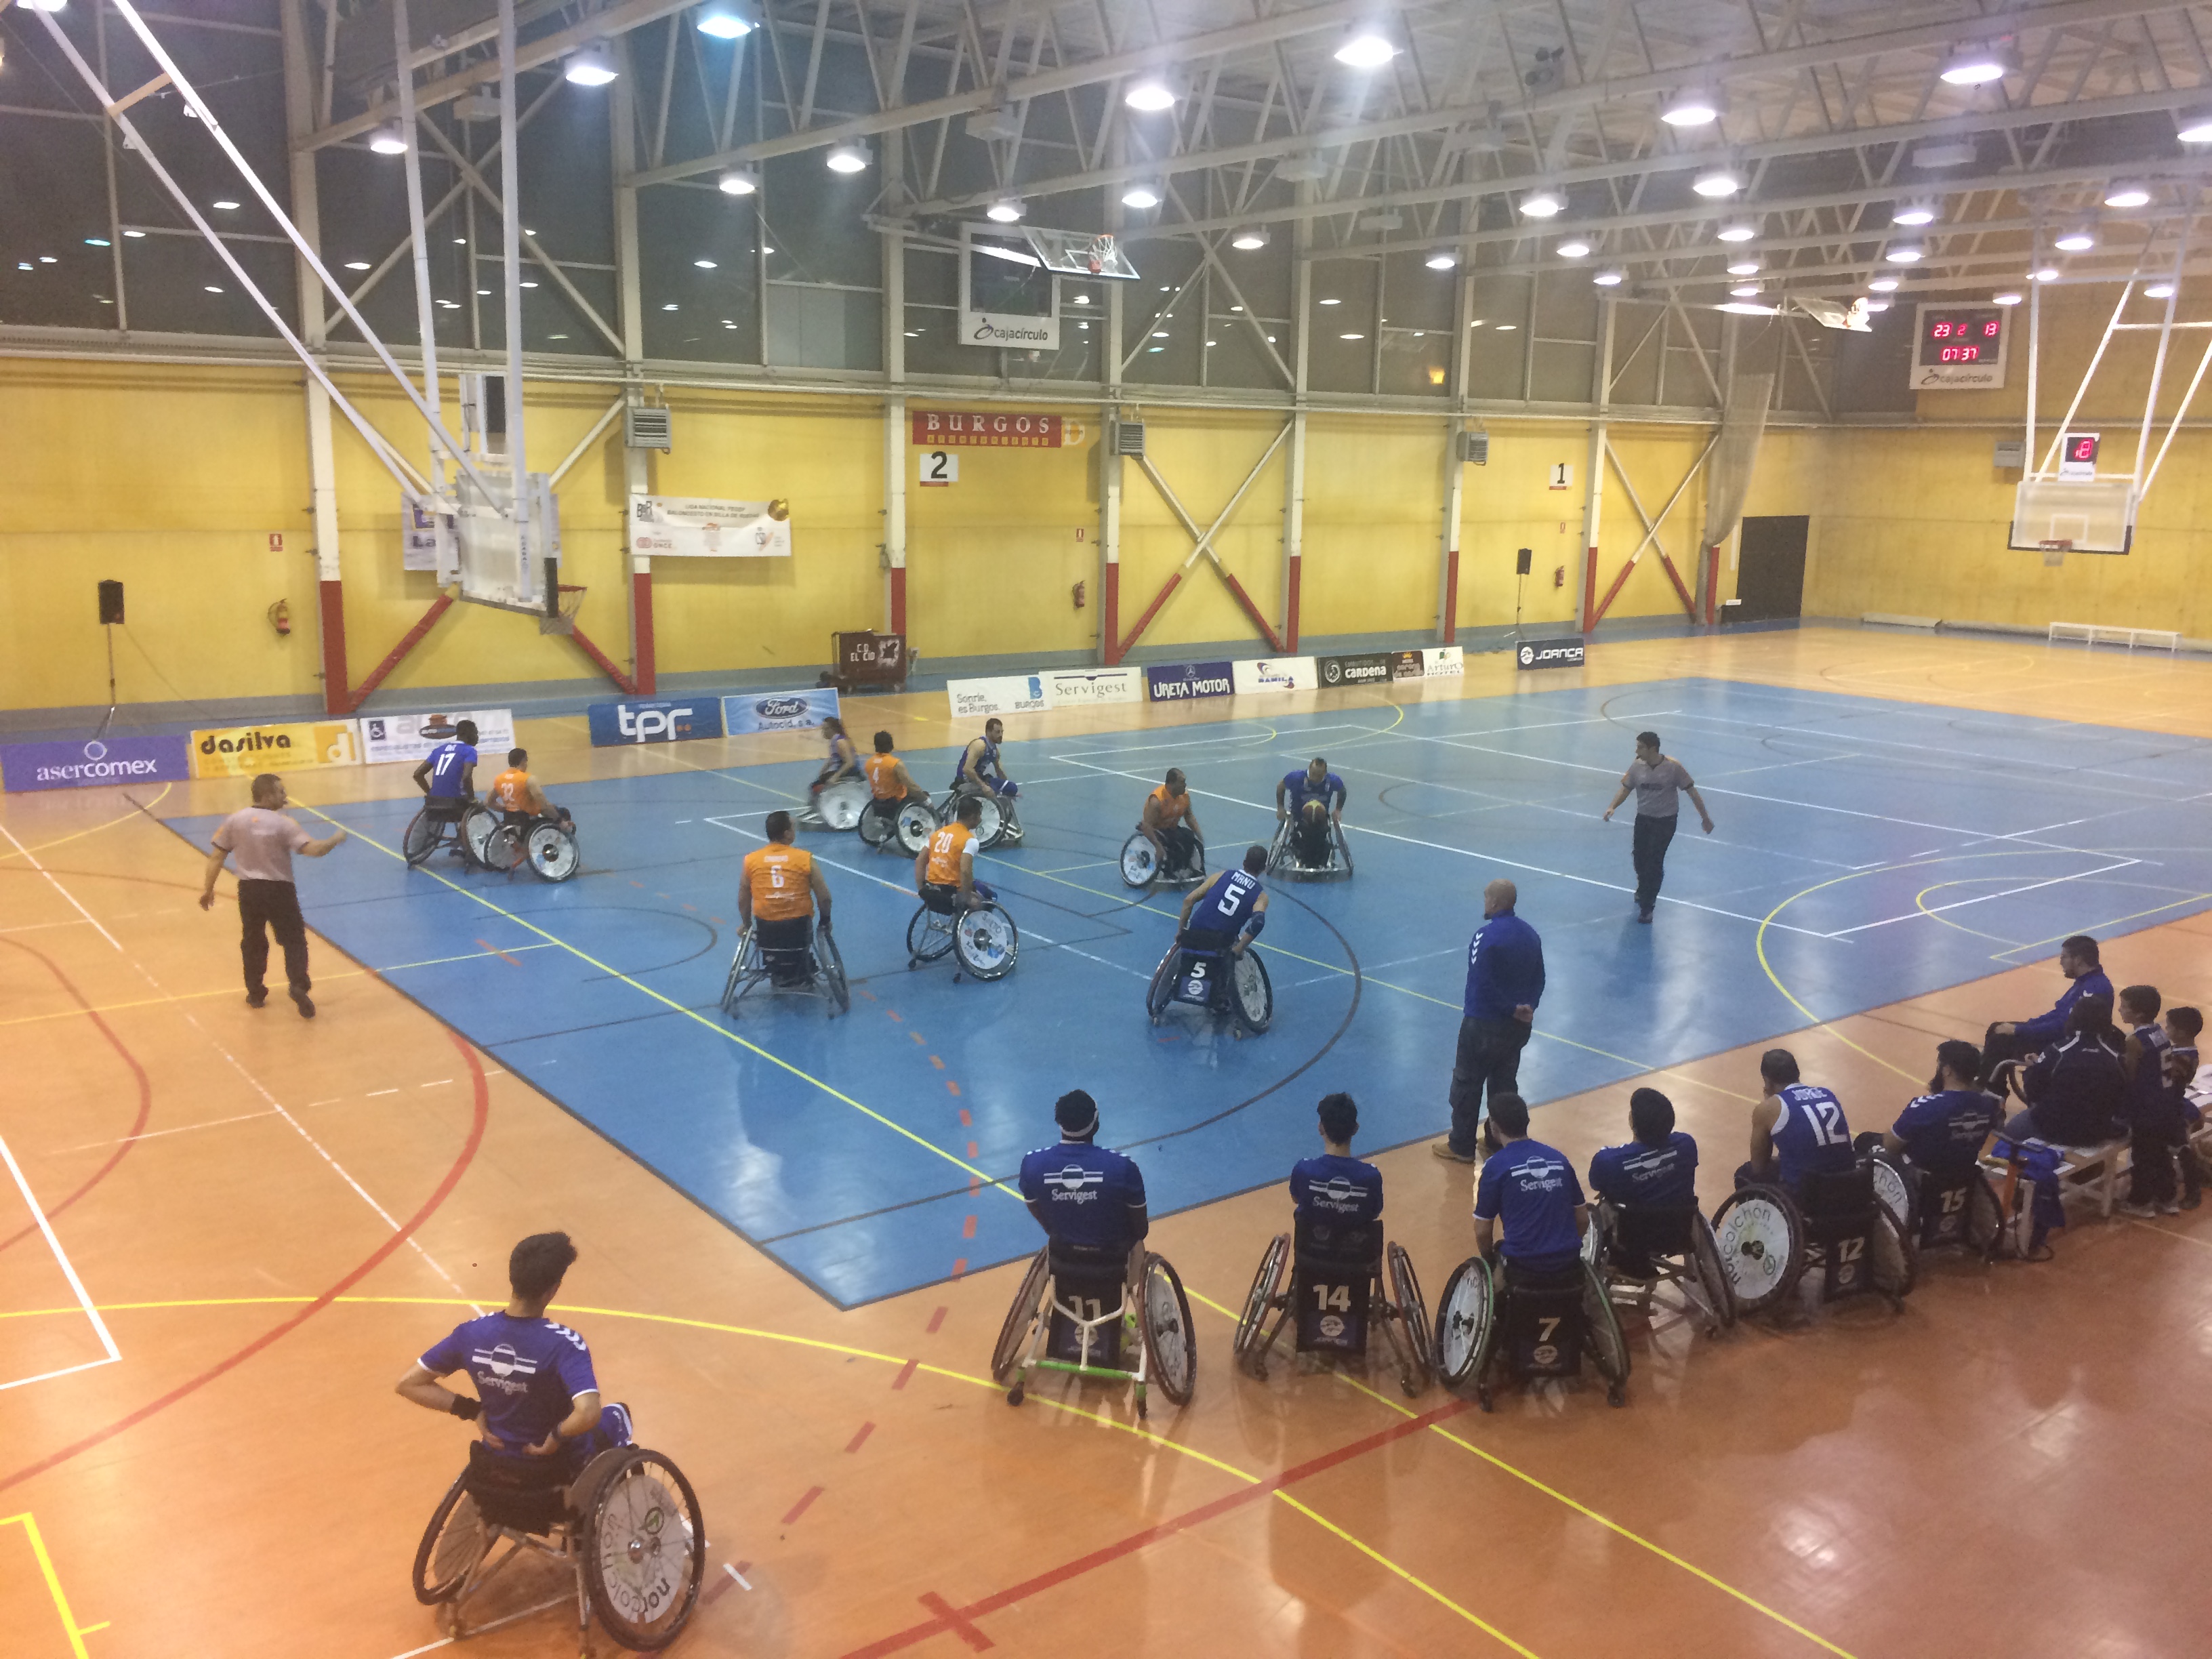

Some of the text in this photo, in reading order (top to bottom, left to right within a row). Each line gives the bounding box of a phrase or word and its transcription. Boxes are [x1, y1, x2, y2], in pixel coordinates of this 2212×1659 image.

[994, 327, 1048, 341] cajacírculo
[1933, 324, 1950, 337] 23
[1985, 323, 1997, 335] 13
[927, 413, 1049, 434] BURGOS
[930, 451, 947, 479] 2
[1557, 463, 1565, 484] 1
[1056, 682, 1128, 697] Servigest
[1154, 678, 1230, 699] URETA MOTOR
[765, 698, 800, 715] Ford
[618, 705, 693, 742] tpr
[201, 732, 290, 754] dasilva
[37, 759, 157, 781] asercomex
[435, 753, 455, 775] 17
[934, 832, 954, 853] 20
[771, 865, 784, 888] 6
[1231, 872, 1255, 889] MANU
[1217, 884, 1246, 916] 5
[1191, 962, 1206, 978] 5
[1801, 1101, 1847, 1147] 12
[1052, 1189, 1097, 1205] Servigest
[1838, 1237, 1864, 1263] 12
[1313, 1285, 1351, 1312] 14
[1539, 1317, 1561, 1342] 7
[477, 1370, 528, 1395] Servigest
